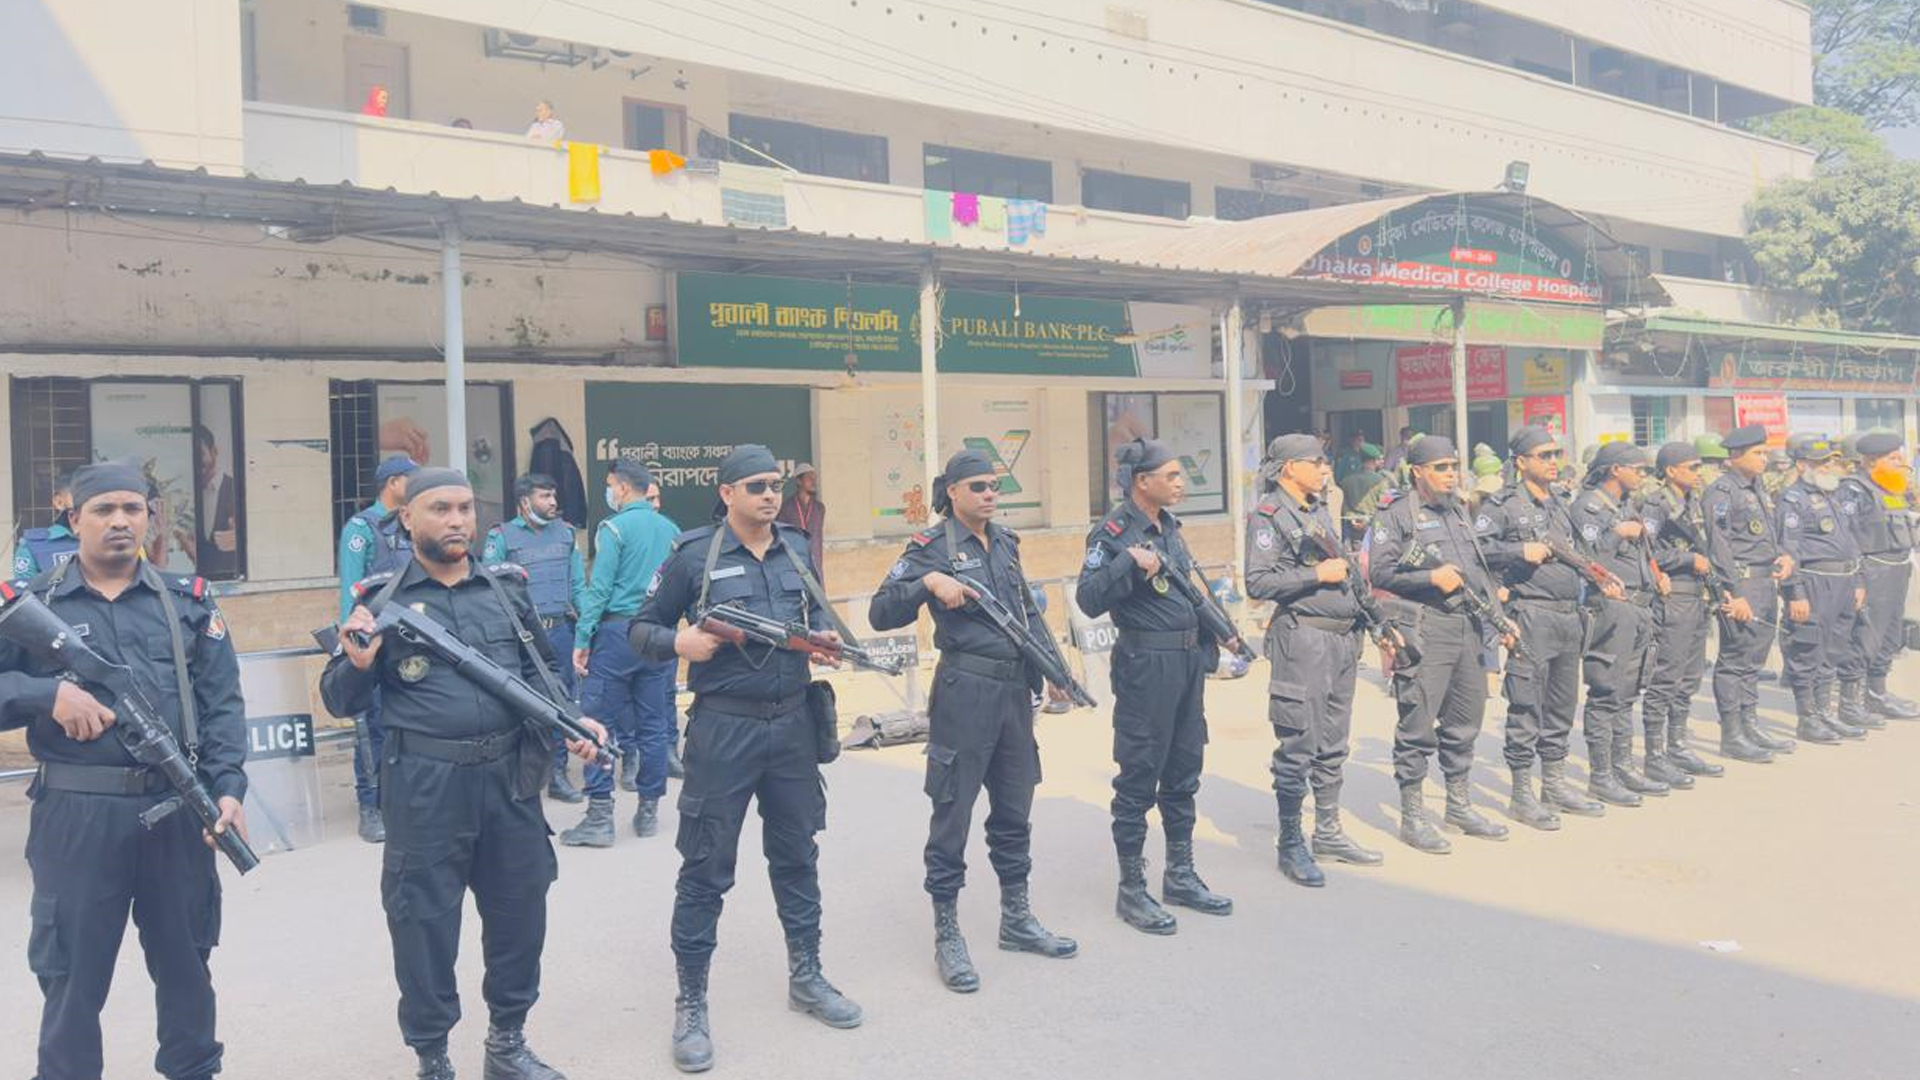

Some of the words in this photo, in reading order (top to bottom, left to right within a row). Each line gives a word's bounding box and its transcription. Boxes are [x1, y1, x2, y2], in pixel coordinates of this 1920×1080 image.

[1380, 259, 1458, 283] Medical
[1464, 271, 1532, 292] College
[1537, 277, 1603, 299] Hospital
[775, 305, 827, 329] ব্যাংক
[951, 317, 1019, 338] PUBALI
[1024, 320, 1072, 340] BANK
[1077, 323, 1110, 342] PLC
[1085, 627, 1120, 649] POLI
[247, 722, 308, 753] LICE
